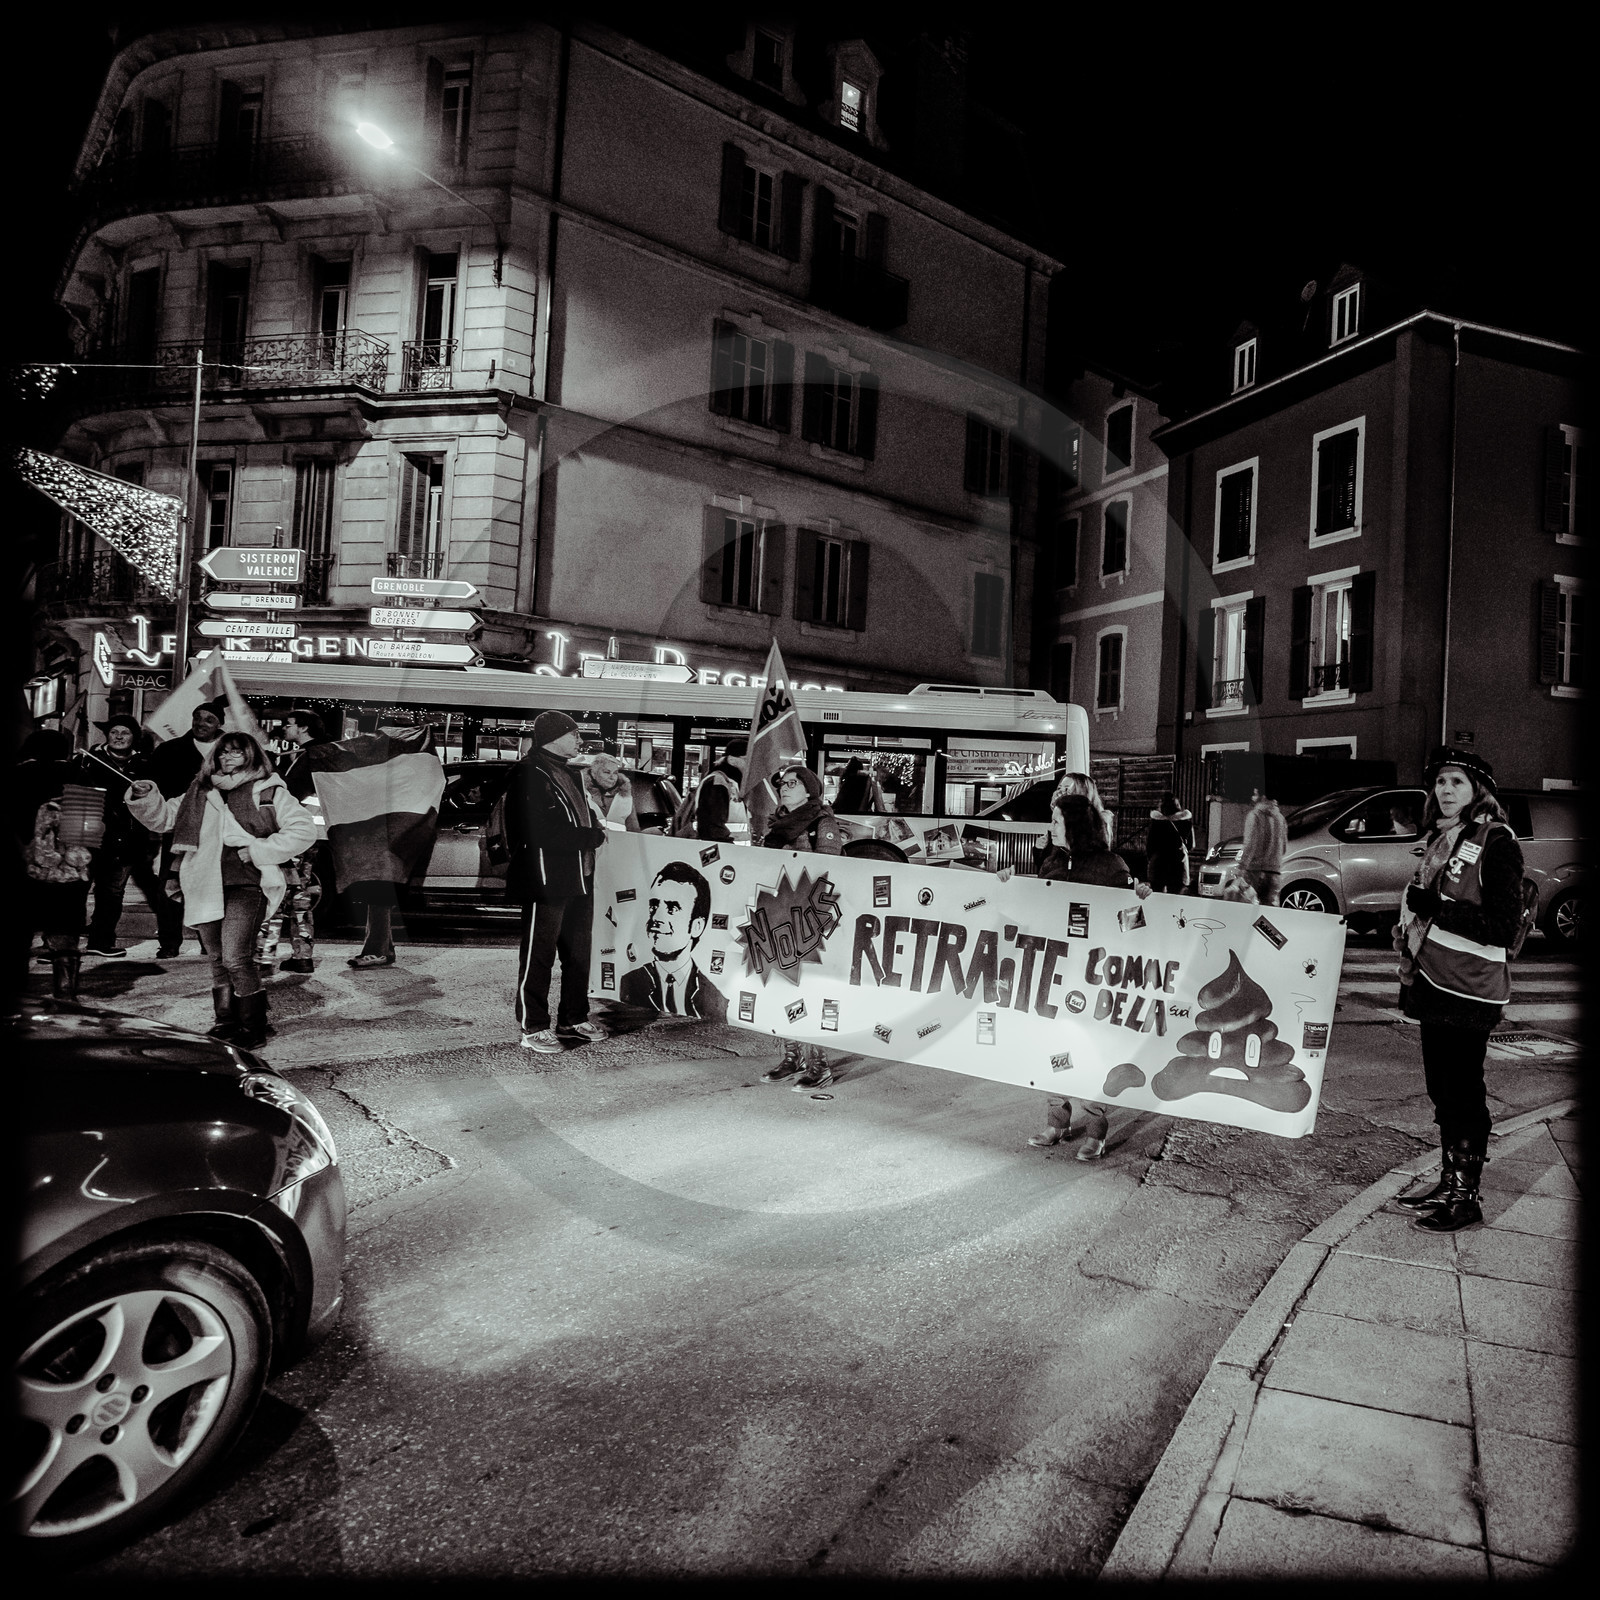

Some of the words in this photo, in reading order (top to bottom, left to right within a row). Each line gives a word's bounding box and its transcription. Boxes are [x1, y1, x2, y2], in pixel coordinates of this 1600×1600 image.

[239, 553, 296, 564] SISTERON
[246, 566, 295, 576] VALENCE
[376, 582, 426, 592] GRENOBLE
[255, 596, 294, 604] GRENOBLE
[375, 617, 417, 625] ORCIERES
[225, 625, 261, 634] CENTRE
[266, 626, 292, 635] VILLE
[373, 642, 387, 650] Col
[390, 643, 422, 651] BAYARD
[118, 673, 167, 688] TABAC
[745, 876, 843, 974] NOUS
[1084, 946, 1180, 995] COMME
